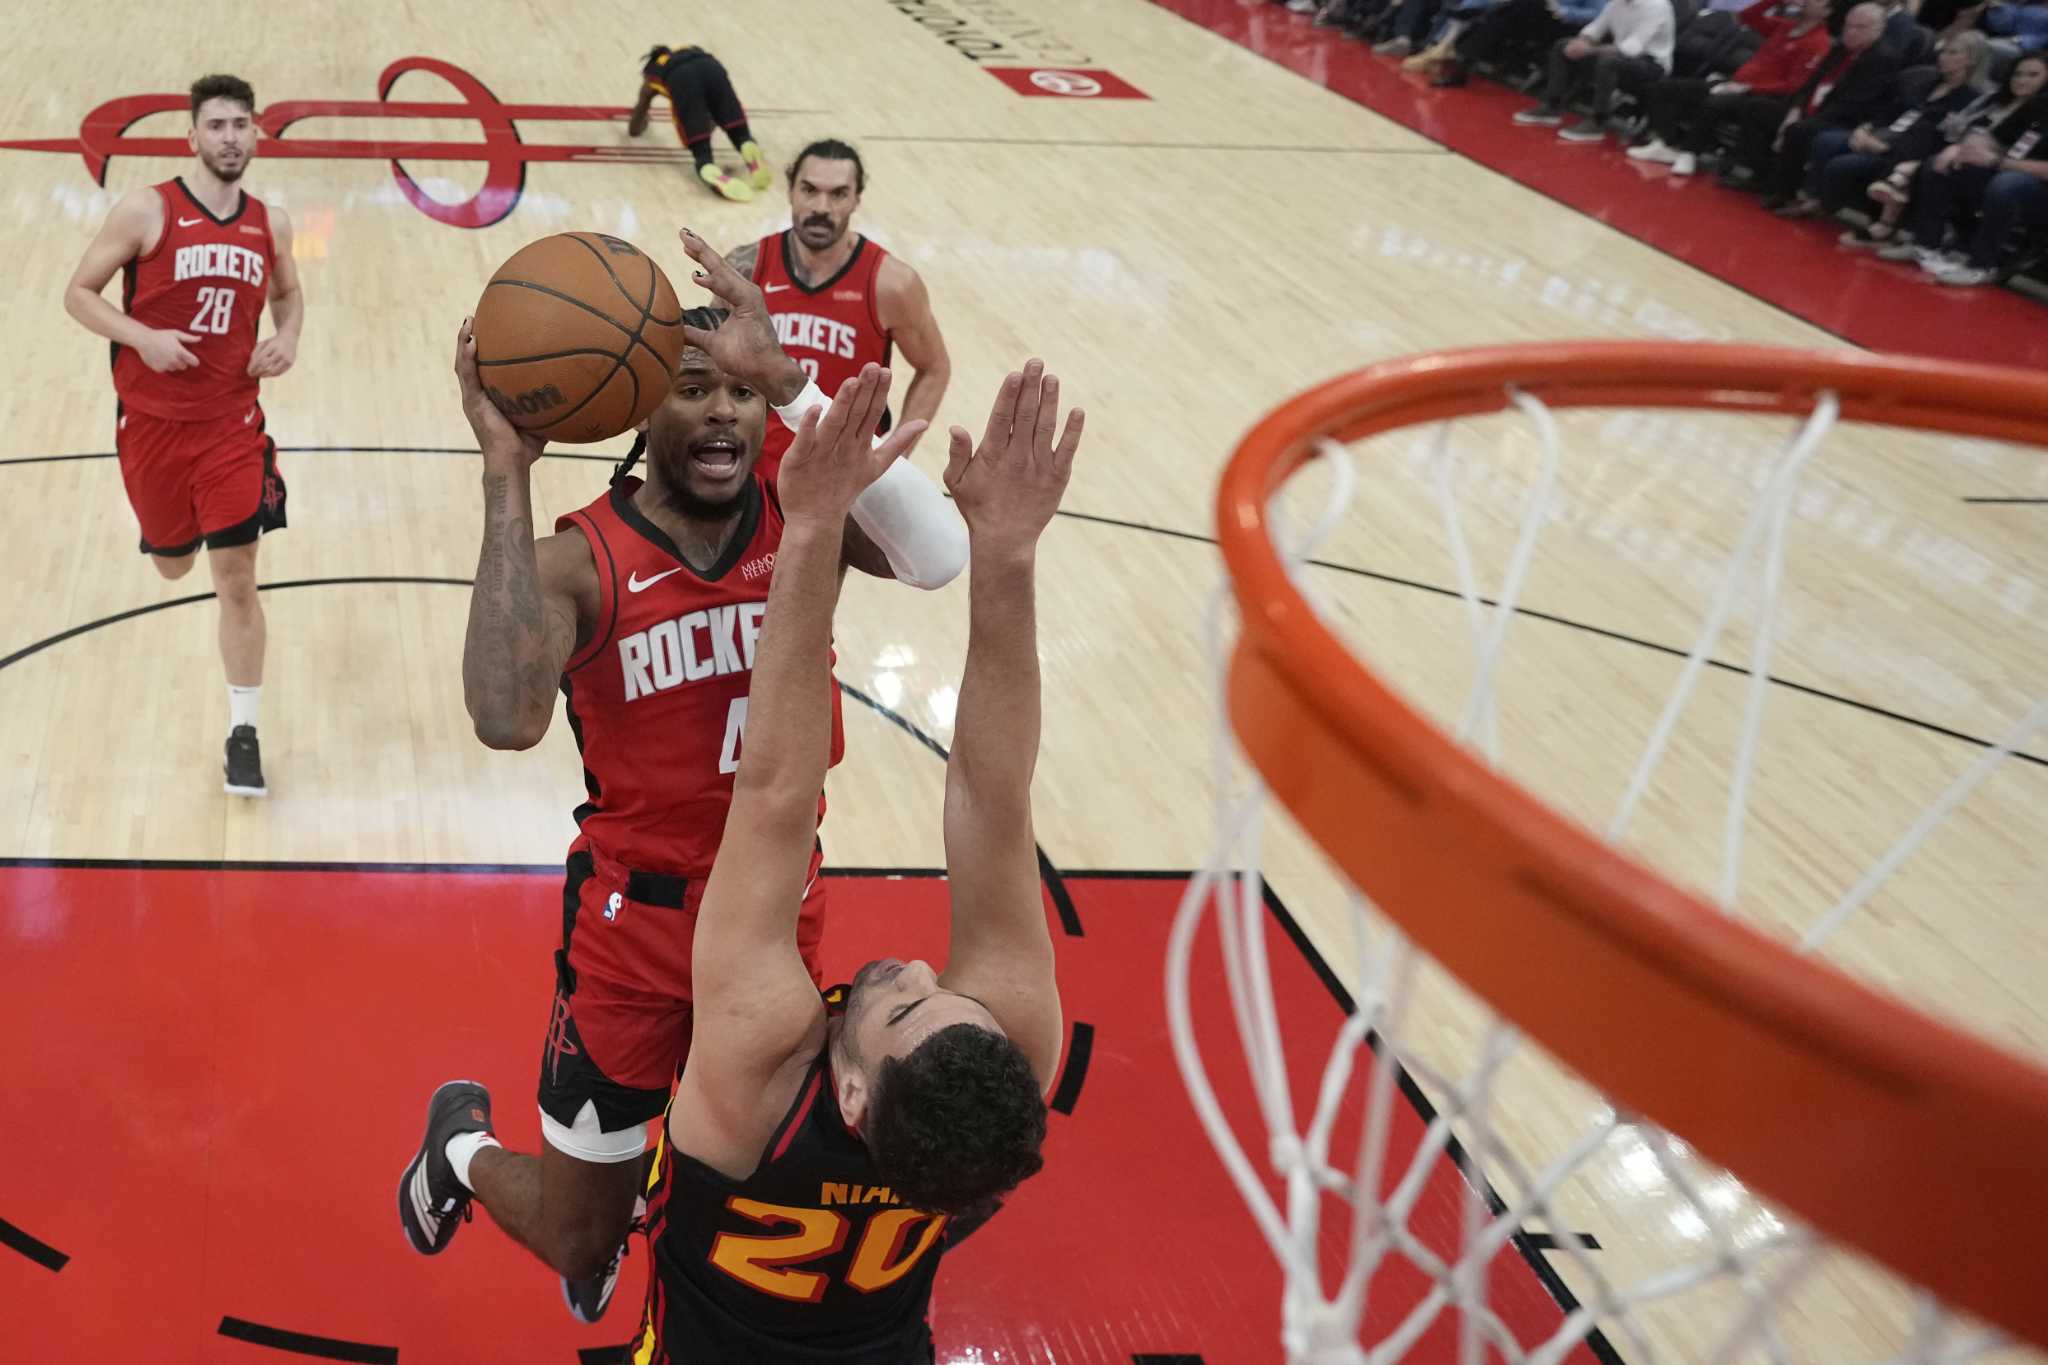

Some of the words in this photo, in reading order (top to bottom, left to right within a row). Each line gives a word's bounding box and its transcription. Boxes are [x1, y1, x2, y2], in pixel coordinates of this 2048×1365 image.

[174, 243, 264, 287] ROCKETS
[189, 286, 236, 335] 28
[768, 312, 857, 360] OCKETS
[741, 553, 775, 573] MEMO
[618, 602, 766, 703] ROCKE
[820, 1182, 900, 1205] NIA
[707, 1194, 949, 1302] 20
